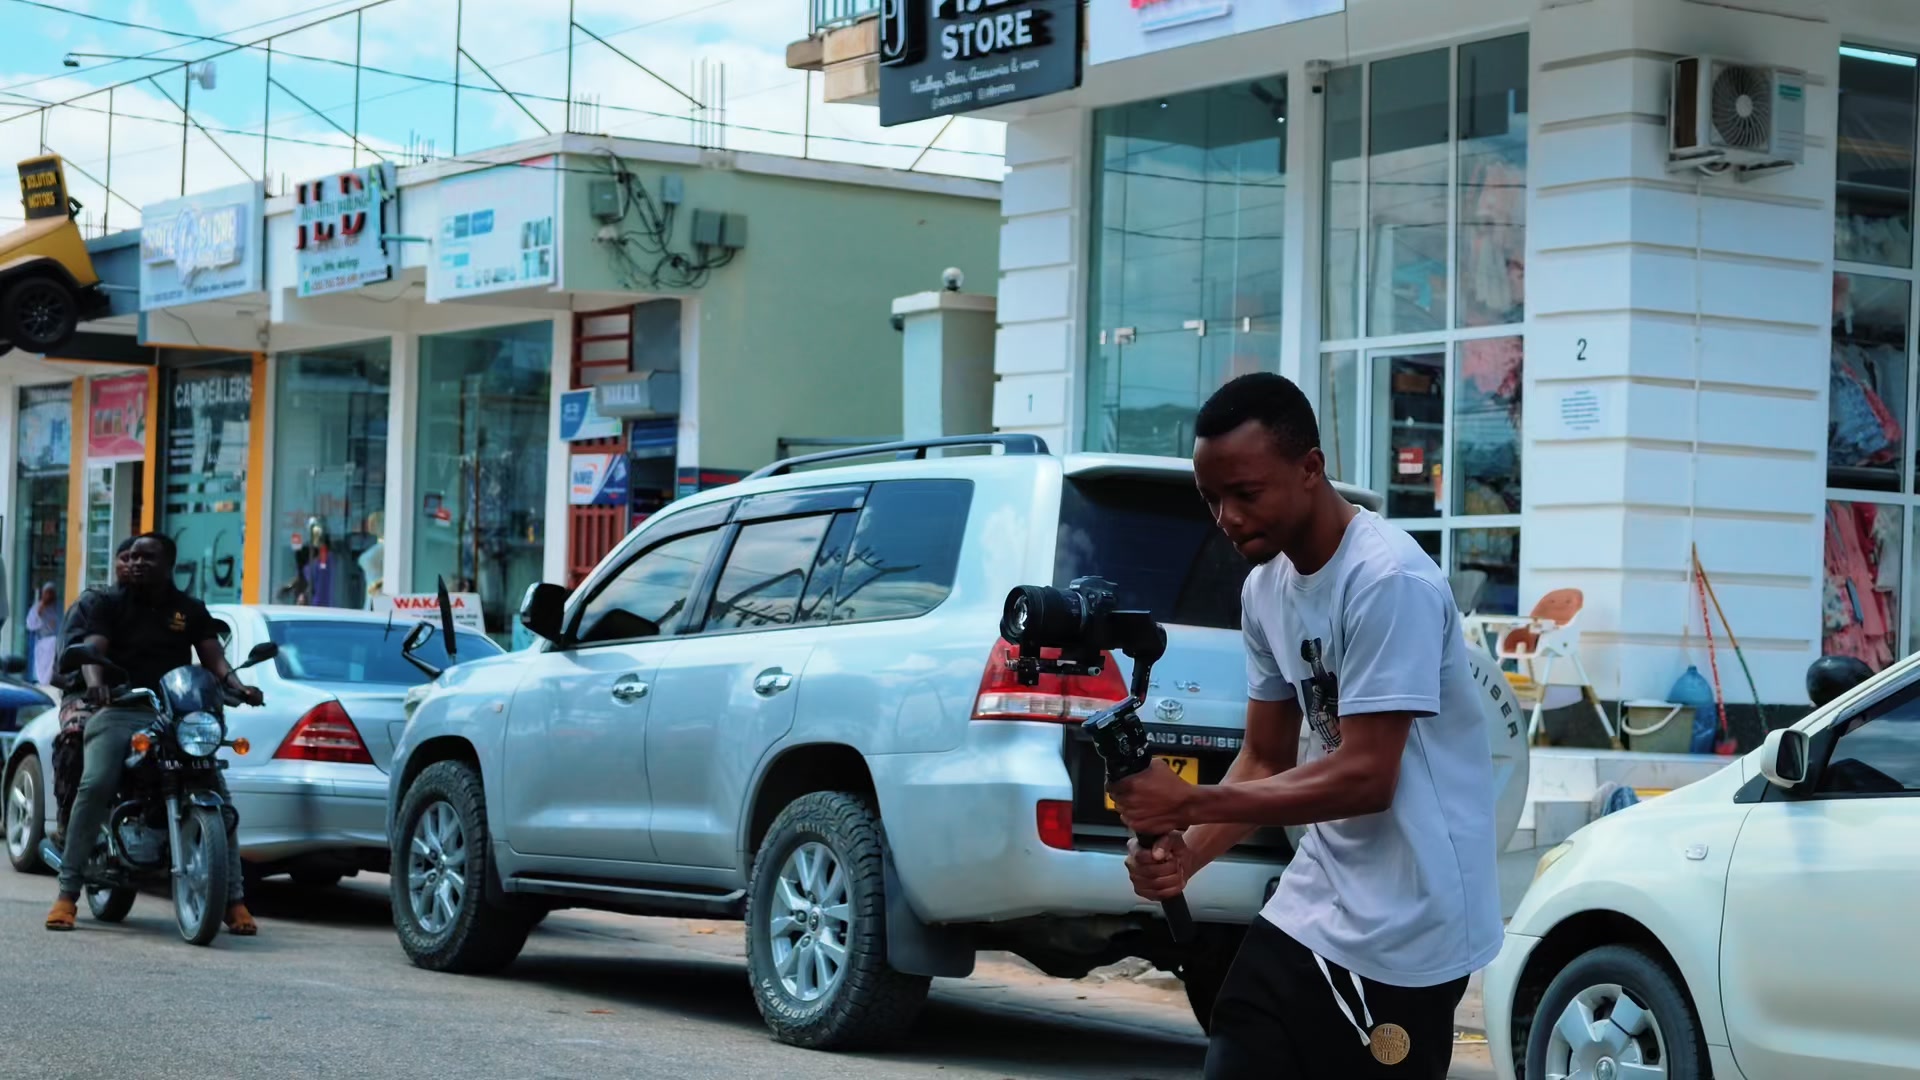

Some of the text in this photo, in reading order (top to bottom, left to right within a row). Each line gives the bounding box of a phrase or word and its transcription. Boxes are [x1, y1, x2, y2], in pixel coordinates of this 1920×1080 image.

[941, 10, 1033, 60] STORE
[1577, 338, 1588, 361] 2
[393, 597, 465, 609] WAKAA
[1146, 732, 1177, 744] AND
